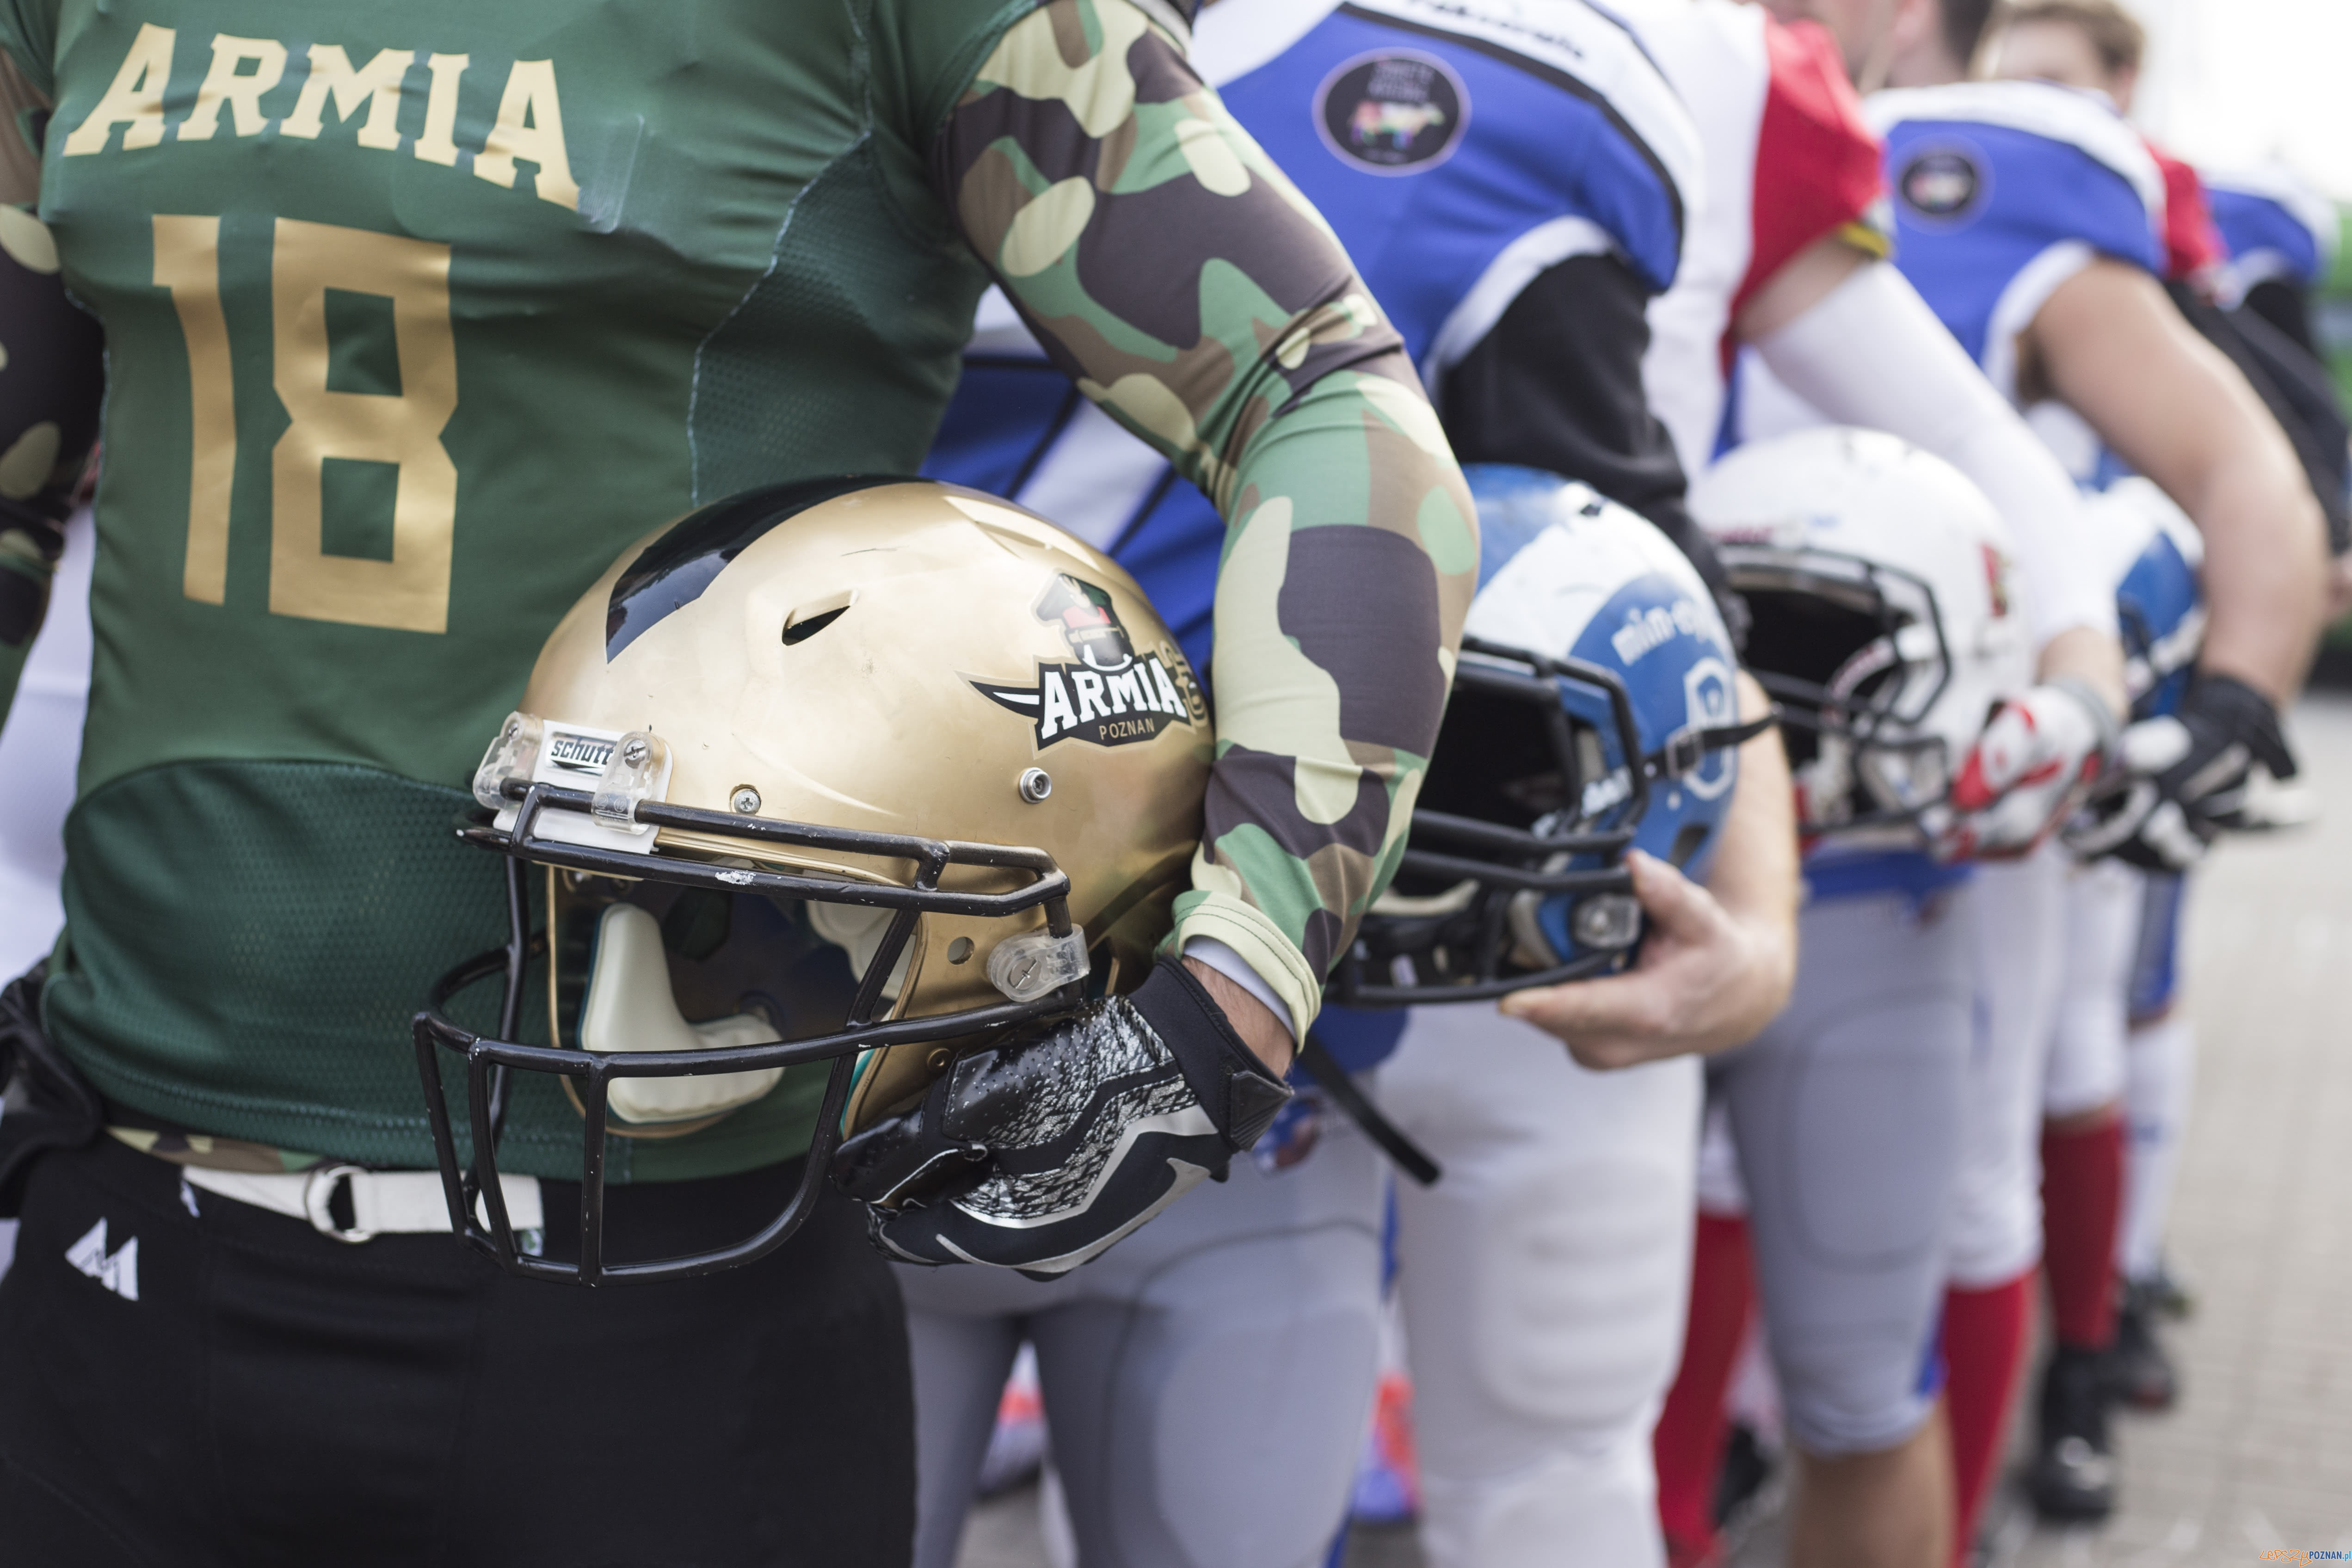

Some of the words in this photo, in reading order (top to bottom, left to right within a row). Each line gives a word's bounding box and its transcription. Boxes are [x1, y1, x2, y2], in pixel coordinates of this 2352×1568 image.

[63, 22, 579, 211] ARMIA
[152, 214, 458, 634] 18
[1041, 658, 1188, 739] ARMIA
[1099, 718, 1155, 740] POZNAN
